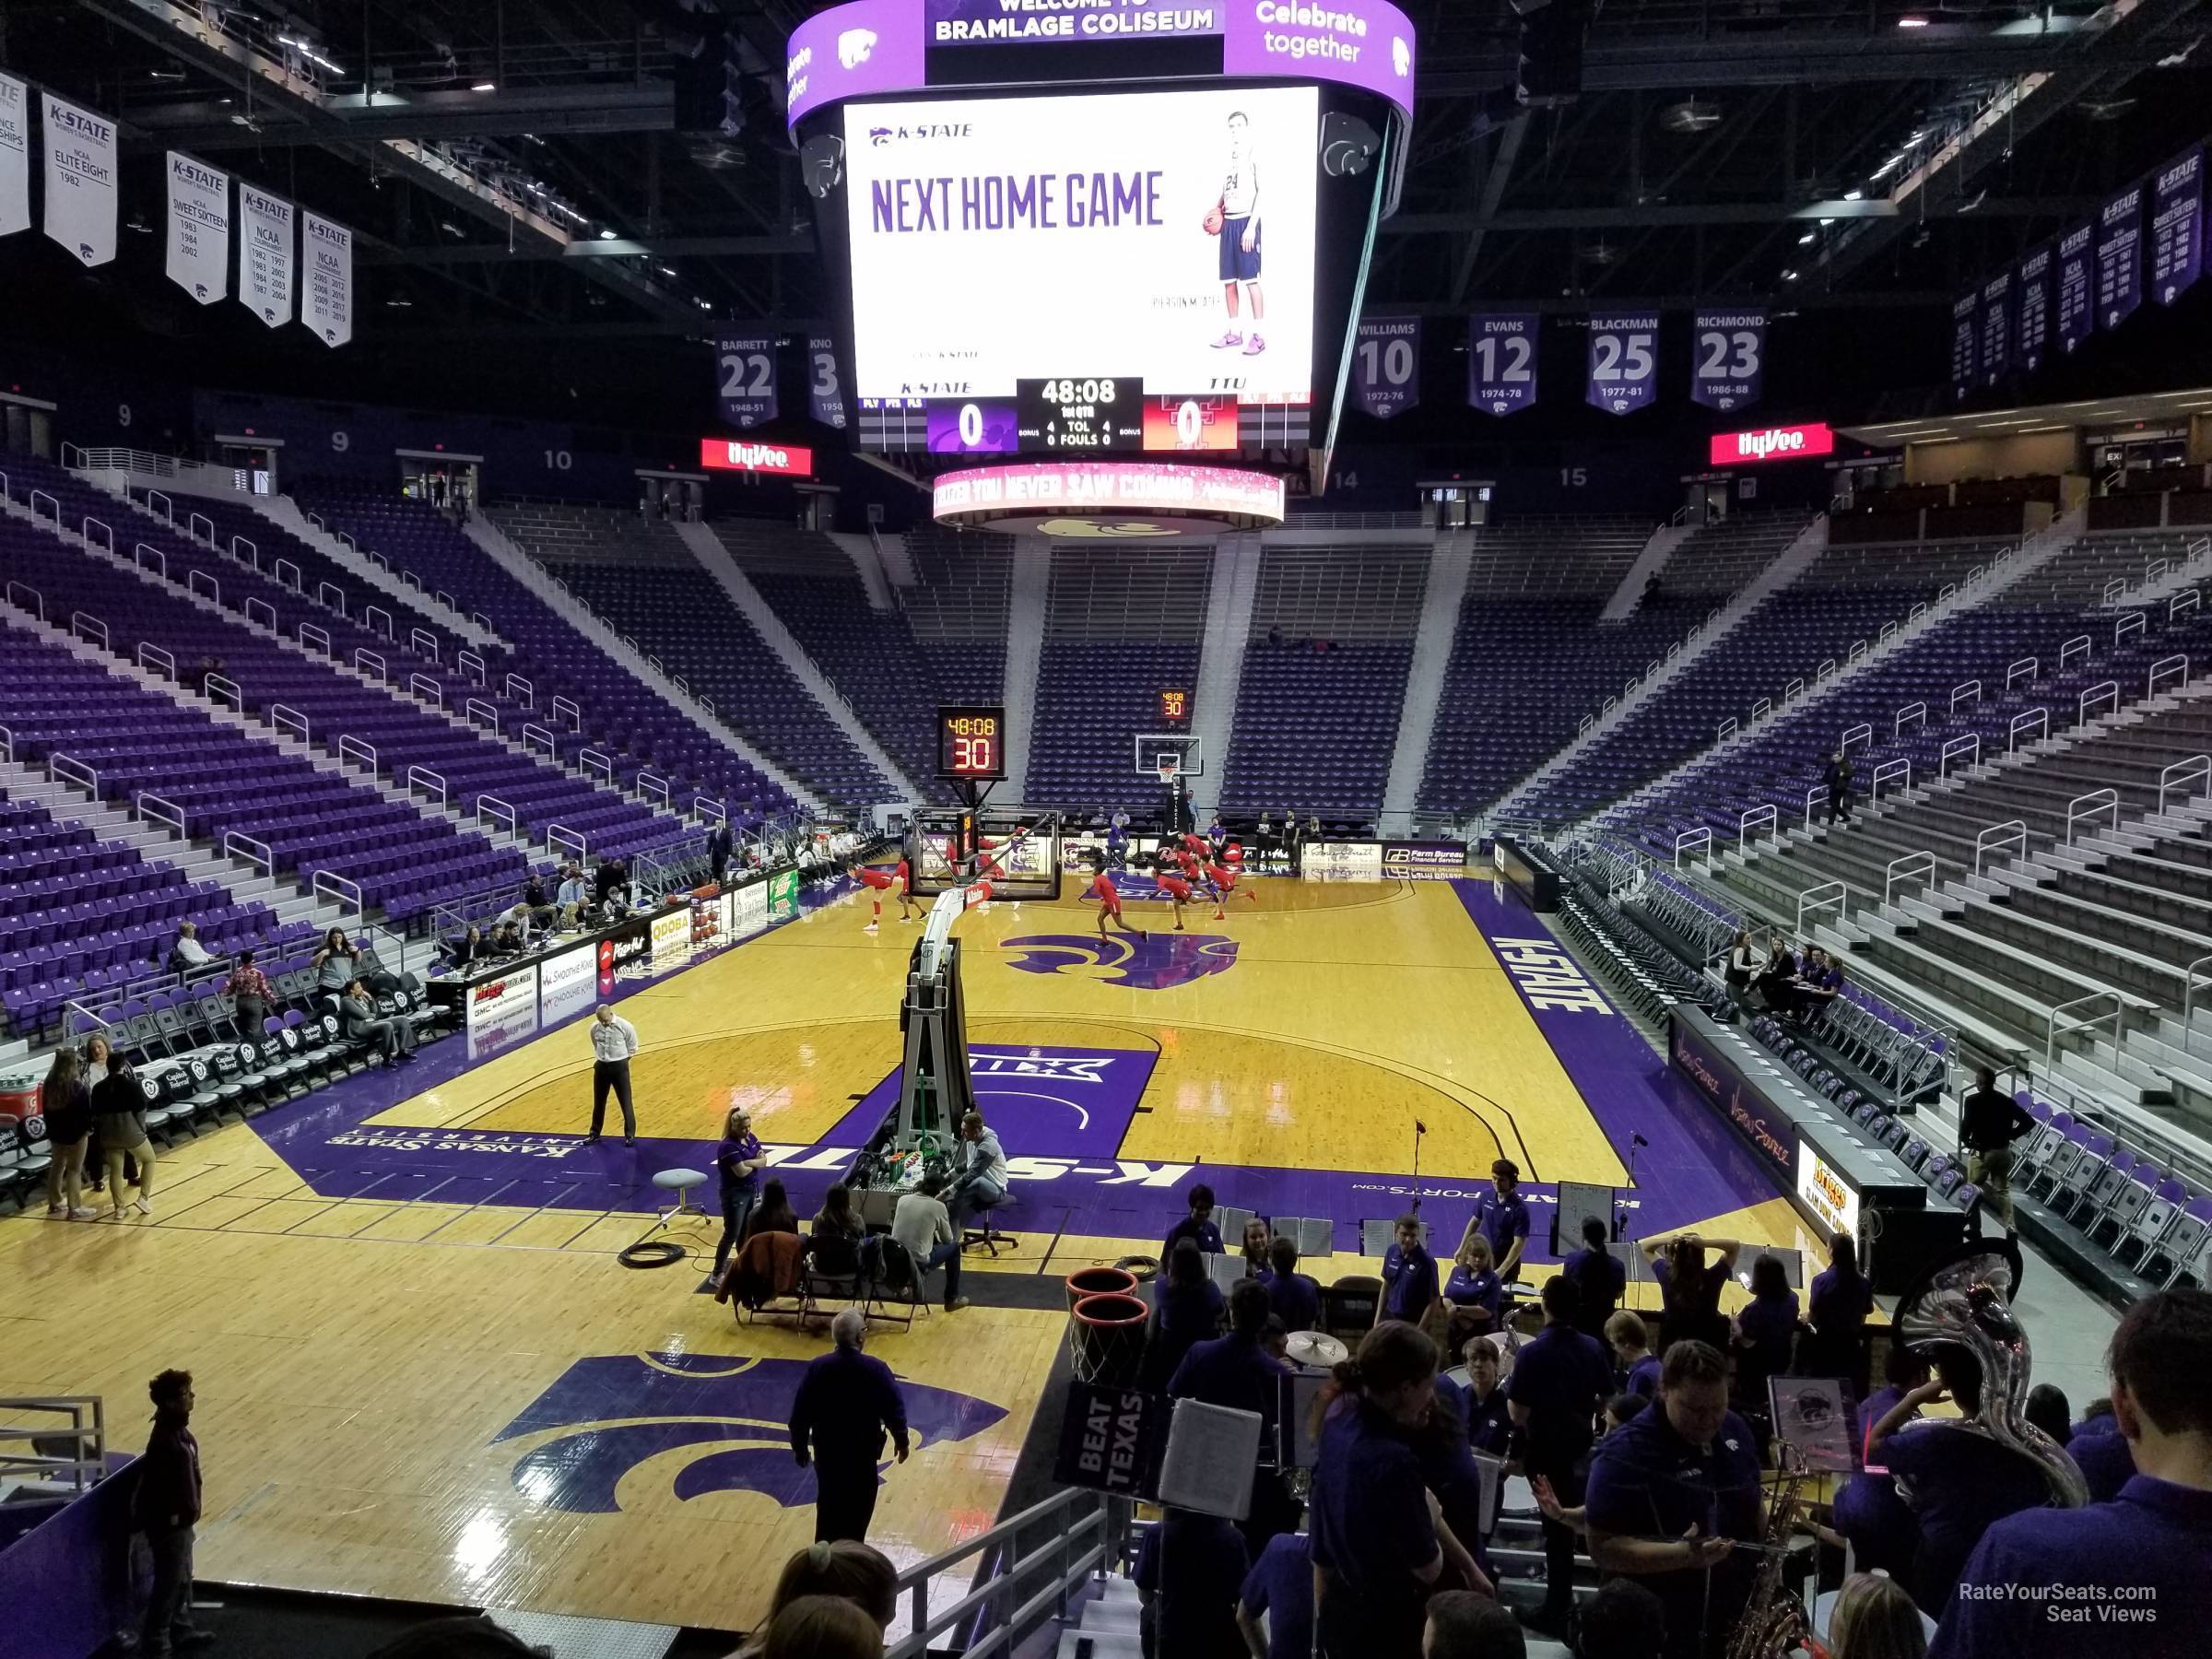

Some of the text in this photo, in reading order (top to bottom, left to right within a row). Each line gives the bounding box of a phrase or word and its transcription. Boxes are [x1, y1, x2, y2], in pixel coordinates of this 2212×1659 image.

[935, 9, 1213, 40] BRAMLAGE COLISEUM
[1256, 0, 1367, 36] Celebrate
[1264, 31, 1360, 63] together
[51, 104, 111, 142] K-STATE
[898, 124, 972, 138] K-STATE
[55, 150, 108, 182] ELITE EIGHT
[173, 159, 222, 192] K-STATE
[2158, 155, 2199, 192] K-STATE
[60, 171, 80, 186] 1982
[245, 192, 288, 220] K-STATE
[872, 171, 1163, 232] NEXT HOME GAME
[2103, 189, 2139, 221] K-STATE
[173, 199, 196, 217] SWEET
[197, 209, 228, 229] SIXTEEN
[181, 219, 196, 232] 1983
[256, 226, 279, 245] NCAA
[309, 219, 347, 246] K-STATE
[181, 232, 197, 245] 1984
[182, 244, 197, 257] 2002
[252, 248, 285, 267] 1982 1997
[318, 252, 338, 269] NCAA
[1359, 324, 1415, 335] WILLIAMS
[1485, 322, 1524, 332] EVANS
[1591, 318, 1657, 330] BLACKMAN
[1697, 316, 1763, 327] RICHMOND
[722, 340, 769, 350] BARRETT
[1698, 332, 1759, 378] 23
[1359, 339, 1413, 384] 10
[1476, 336, 1531, 382] 12
[1593, 335, 1653, 381] 25
[721, 354, 771, 397] 22
[1210, 378, 1246, 390] TTU
[1041, 379, 1115, 403] 48:08
[1366, 392, 1404, 400] 1972-76
[1481, 389, 1522, 398] 1974-78
[1601, 387, 1642, 396] 1977-81
[1707, 385, 1748, 394] 1986-88
[118, 405, 131, 427] 9
[730, 404, 764, 412] 1948-51
[959, 404, 982, 446] 0
[1047, 420, 1111, 432] 4 TOL 4
[1177, 401, 1202, 444] 0
[332, 431, 348, 452] 9
[1018, 429, 1040, 437] BONUS
[1047, 434, 1111, 445] 0 FOULS 0
[545, 450, 571, 469] 10
[1006, 475, 1061, 500] NEVER
[1067, 474, 1115, 499] SAW
[1335, 472, 1358, 488] 14
[1560, 467, 1587, 487] 15
[1162, 692, 1184, 701] 48:08
[1164, 702, 1182, 716] 30
[948, 718, 994, 735] 48:08
[955, 738, 990, 770] 30
[653, 915, 688, 942] QDOBA
[1491, 936, 1614, 1015] K-STATE
[475, 1005, 491, 1017] GMC
[166, 1069, 187, 1082] Capitol
[170, 1077, 189, 1088] Federal
[324, 1135, 580, 1158] KANSAS STATE
[1814, 1157, 1846, 1210] Briggs
[1078, 1395, 1112, 1473] BEAT
[1107, 1394, 1143, 1487] TEXAS
